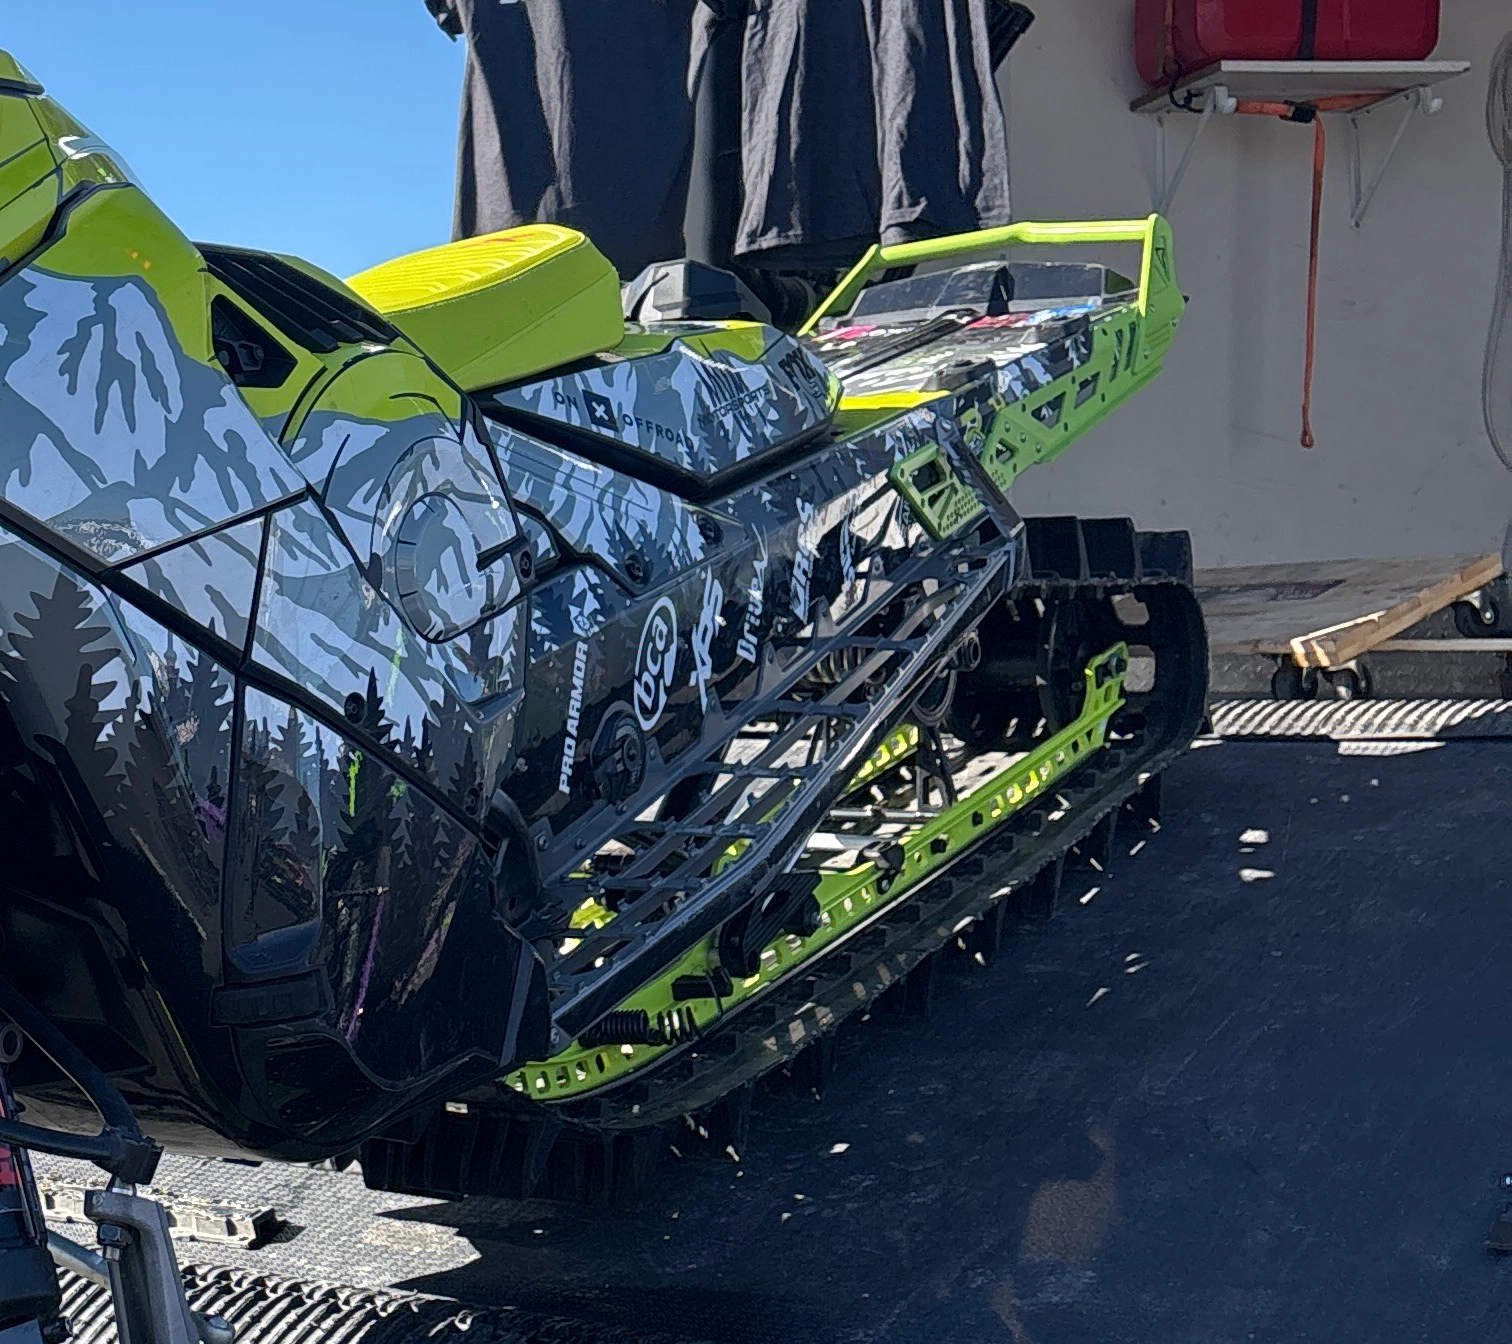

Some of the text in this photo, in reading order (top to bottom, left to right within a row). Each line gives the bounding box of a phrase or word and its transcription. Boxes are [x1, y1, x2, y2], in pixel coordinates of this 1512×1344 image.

[559, 640, 588, 794] PRO ARMOR
[635, 614, 669, 711] bca
